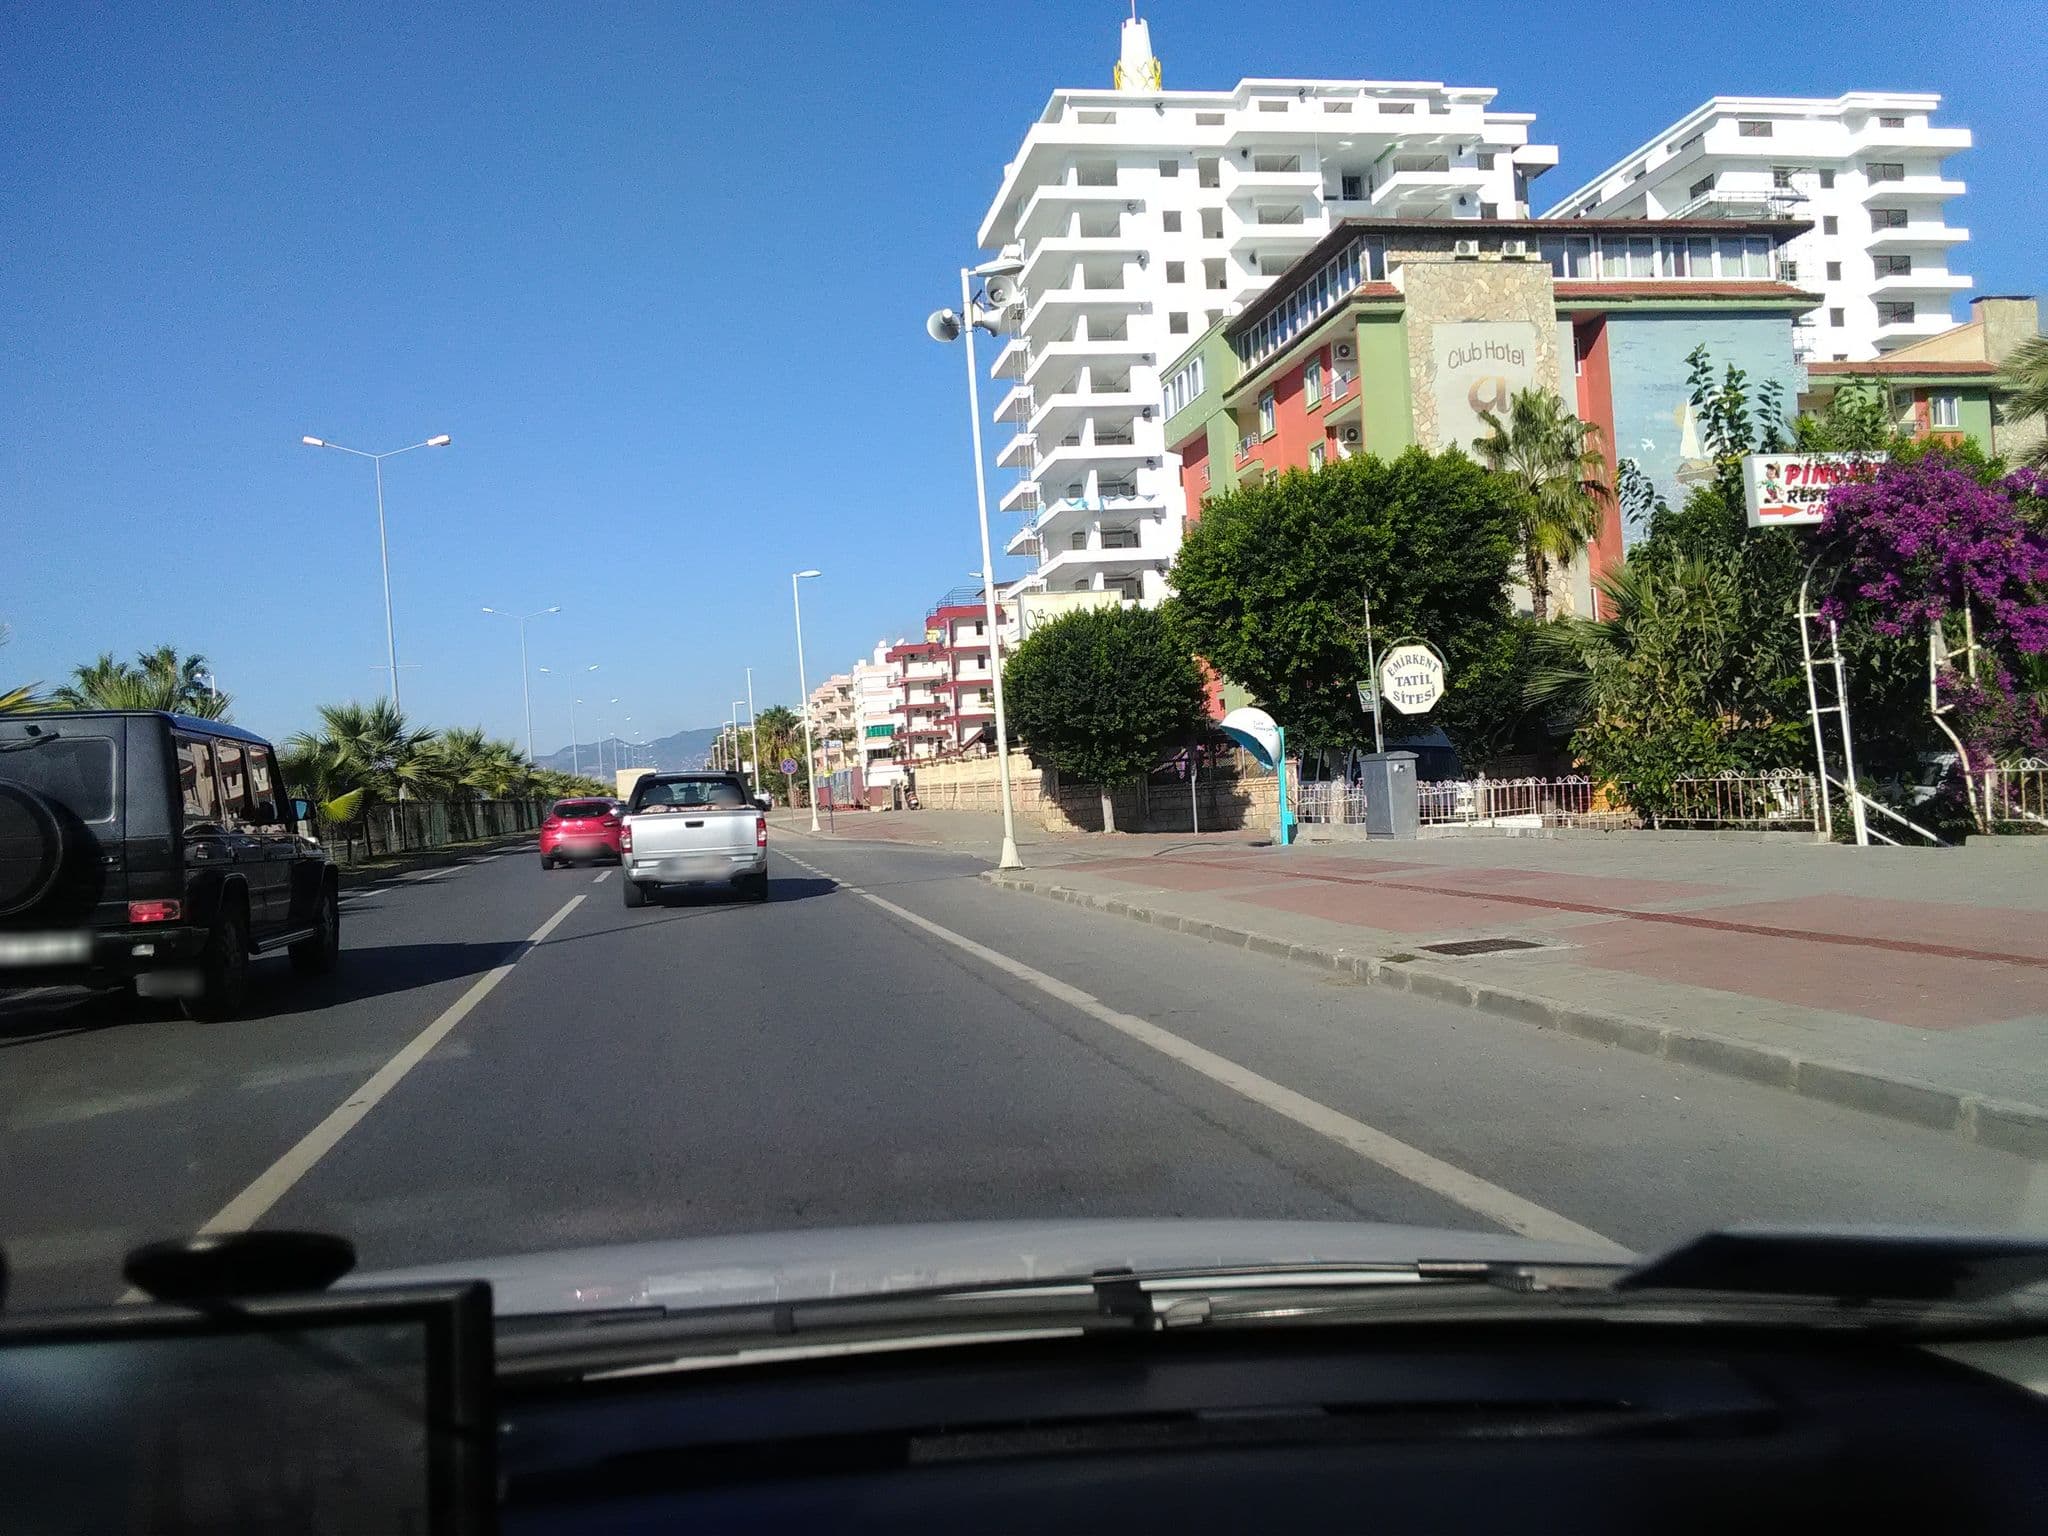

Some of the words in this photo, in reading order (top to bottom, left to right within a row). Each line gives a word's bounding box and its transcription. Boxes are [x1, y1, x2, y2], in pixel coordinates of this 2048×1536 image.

[1448, 342, 1482, 370] Club
[1484, 340, 1525, 367] Hotel
[1387, 654, 1439, 677] EMİRKENT
[1395, 672, 1433, 687] TATİL
[1393, 684, 1436, 705] SİTESİ
